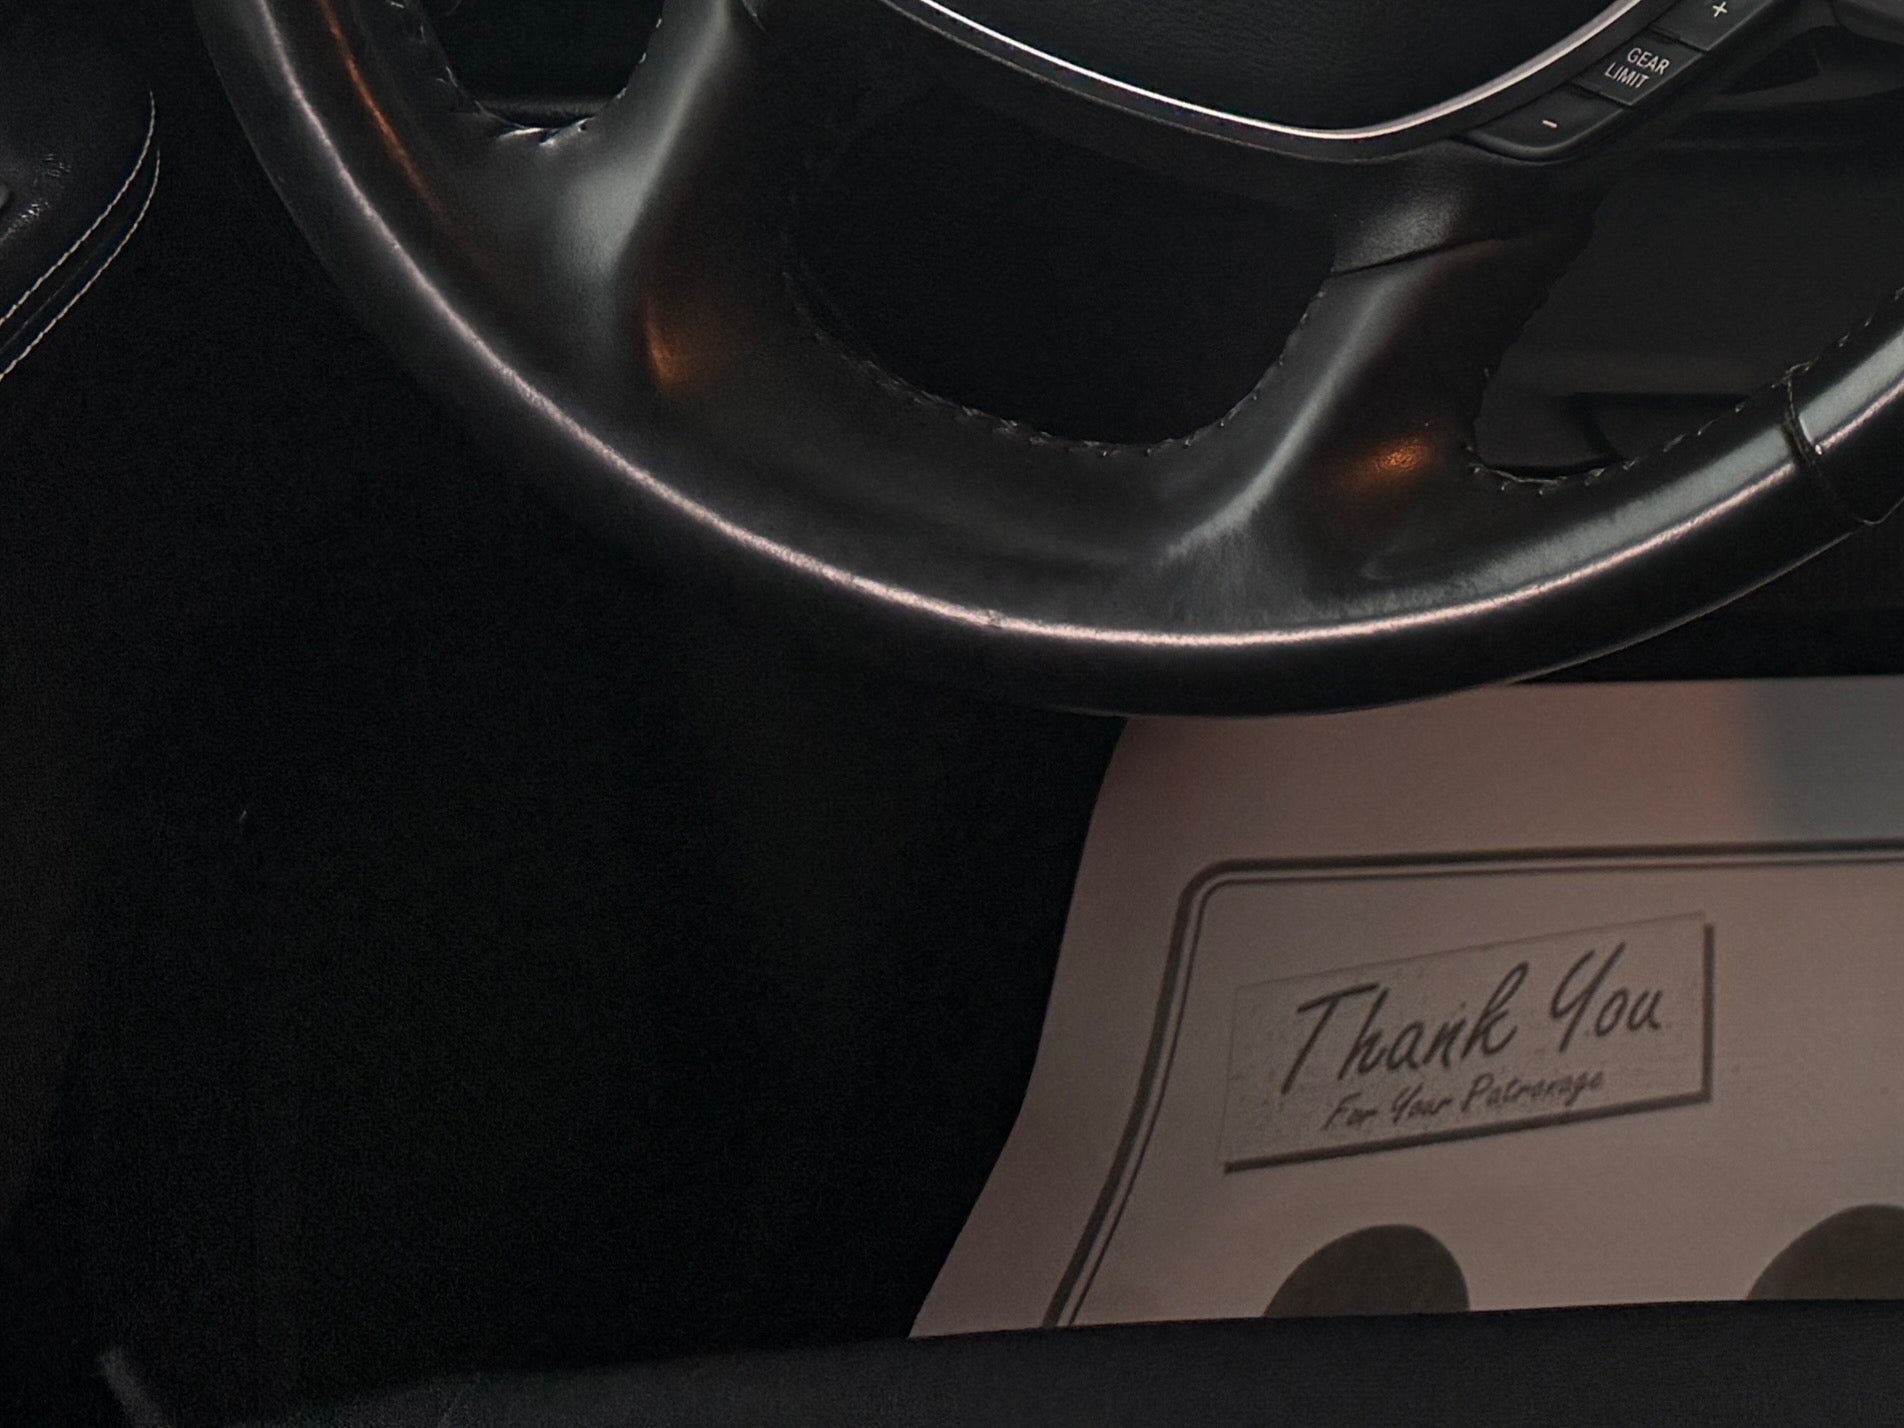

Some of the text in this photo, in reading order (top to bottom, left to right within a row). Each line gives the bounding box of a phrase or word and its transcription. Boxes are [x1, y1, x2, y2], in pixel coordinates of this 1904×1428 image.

[1605, 61, 1649, 92] LIMIT
[1626, 47, 1670, 76] GEAR
[1280, 942, 1662, 1096] Thank You
[1323, 1069, 1603, 1132] For Your Patronage
